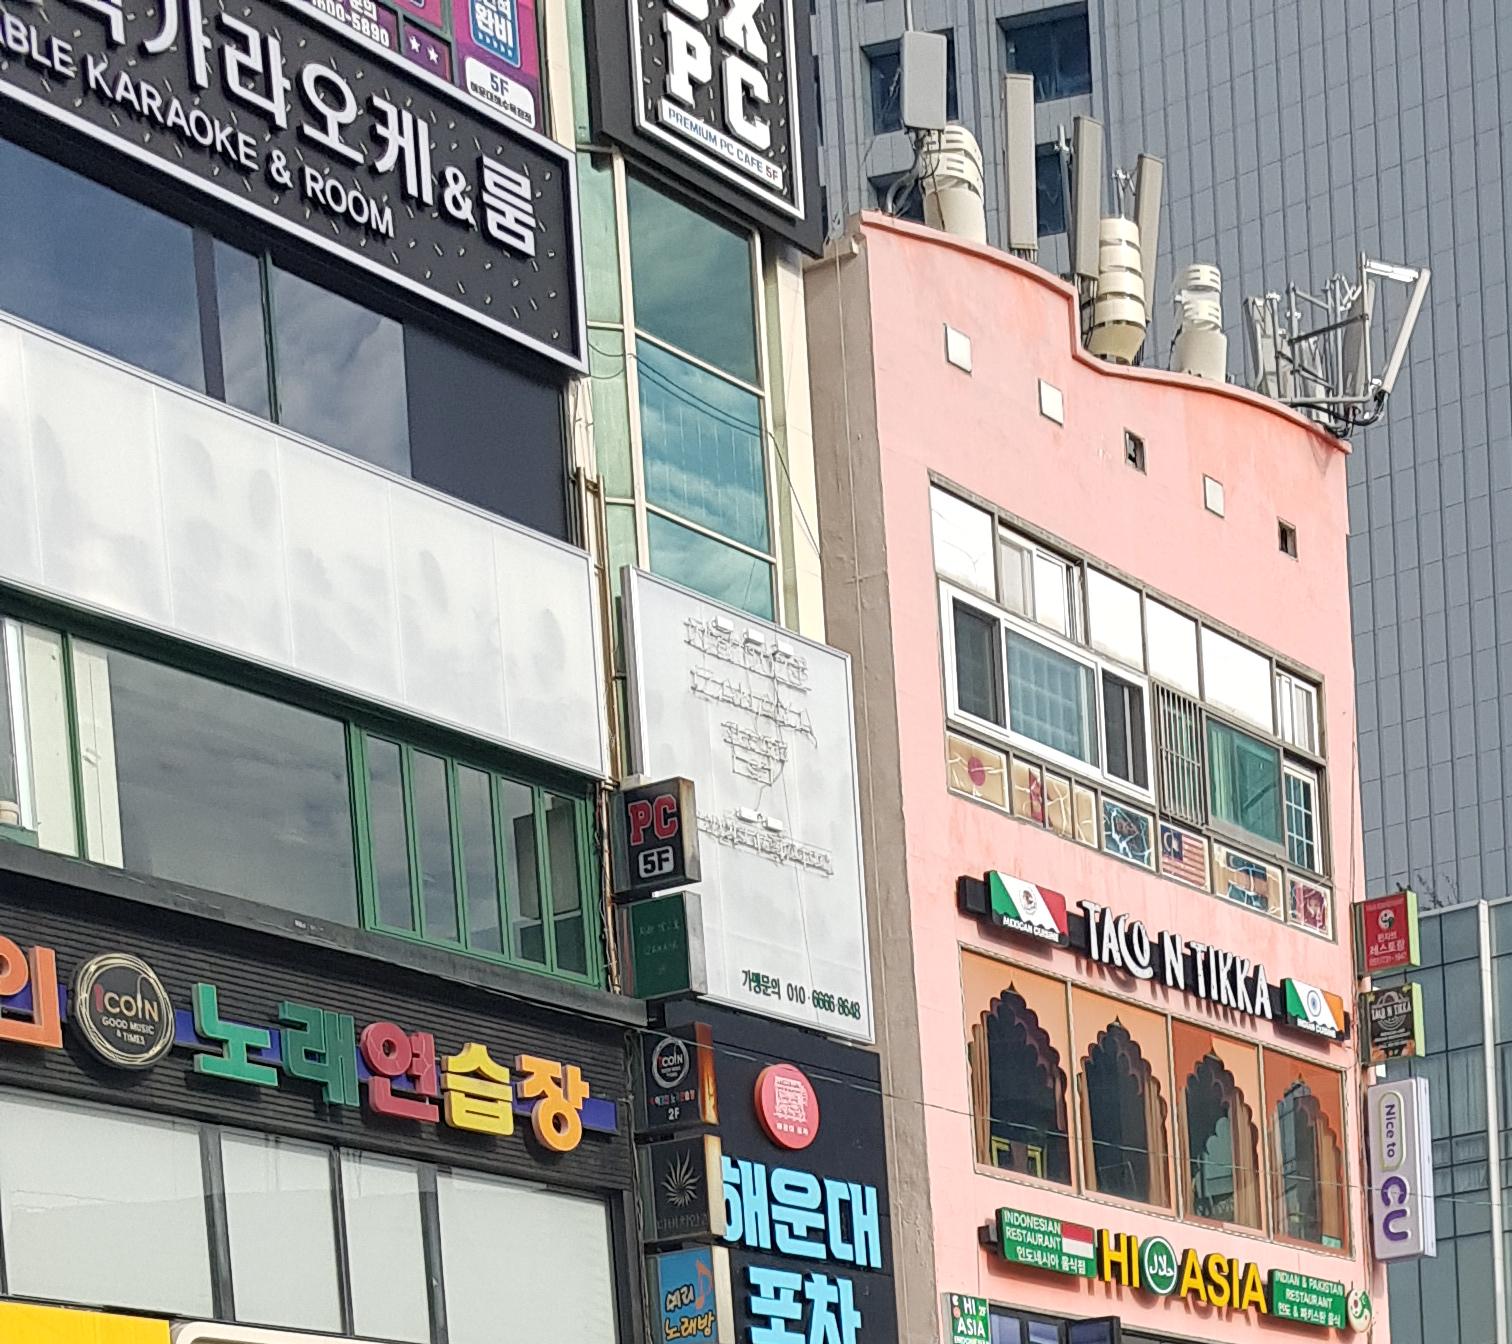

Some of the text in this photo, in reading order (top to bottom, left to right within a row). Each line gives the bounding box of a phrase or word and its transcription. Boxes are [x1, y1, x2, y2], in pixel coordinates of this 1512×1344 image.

[308, 0, 390, 47] 00-5890
[490, 71, 510, 97] 5F
[663, 11, 771, 150] PC
[0, 10, 394, 239] BLE KARAOKE & ROOM
[668, 106, 779, 182] PREMIUM PC CAFE 5F
[628, 793, 679, 846] PC
[643, 849, 670, 874] 5F
[1079, 899, 1273, 1020] TACO N TIKKA
[742, 969, 782, 1000] 가맹문의
[101, 1016, 155, 1035] GOOD MUSIC
[192, 982, 591, 1153] 노래연습장
[668, 1107, 680, 1121] 2F
[1384, 1103, 1396, 1159] Nice to
[721, 1155, 882, 1269] 해운대
[1004, 1210, 1061, 1235] INDONESIAN
[1380, 1175, 1408, 1243] CU
[1005, 1226, 1062, 1251] RESTAURANT
[1016, 1246, 1060, 1270] 인도네시아
[1099, 1229, 1140, 1289] HI
[1179, 1248, 1268, 1315] ASIA
[1285, 1288, 1333, 1309] RESTAURANT
[962, 1297, 977, 1315] HI
[664, 1311, 715, 1341] 노래방
[957, 1316, 987, 1338] ASIA
